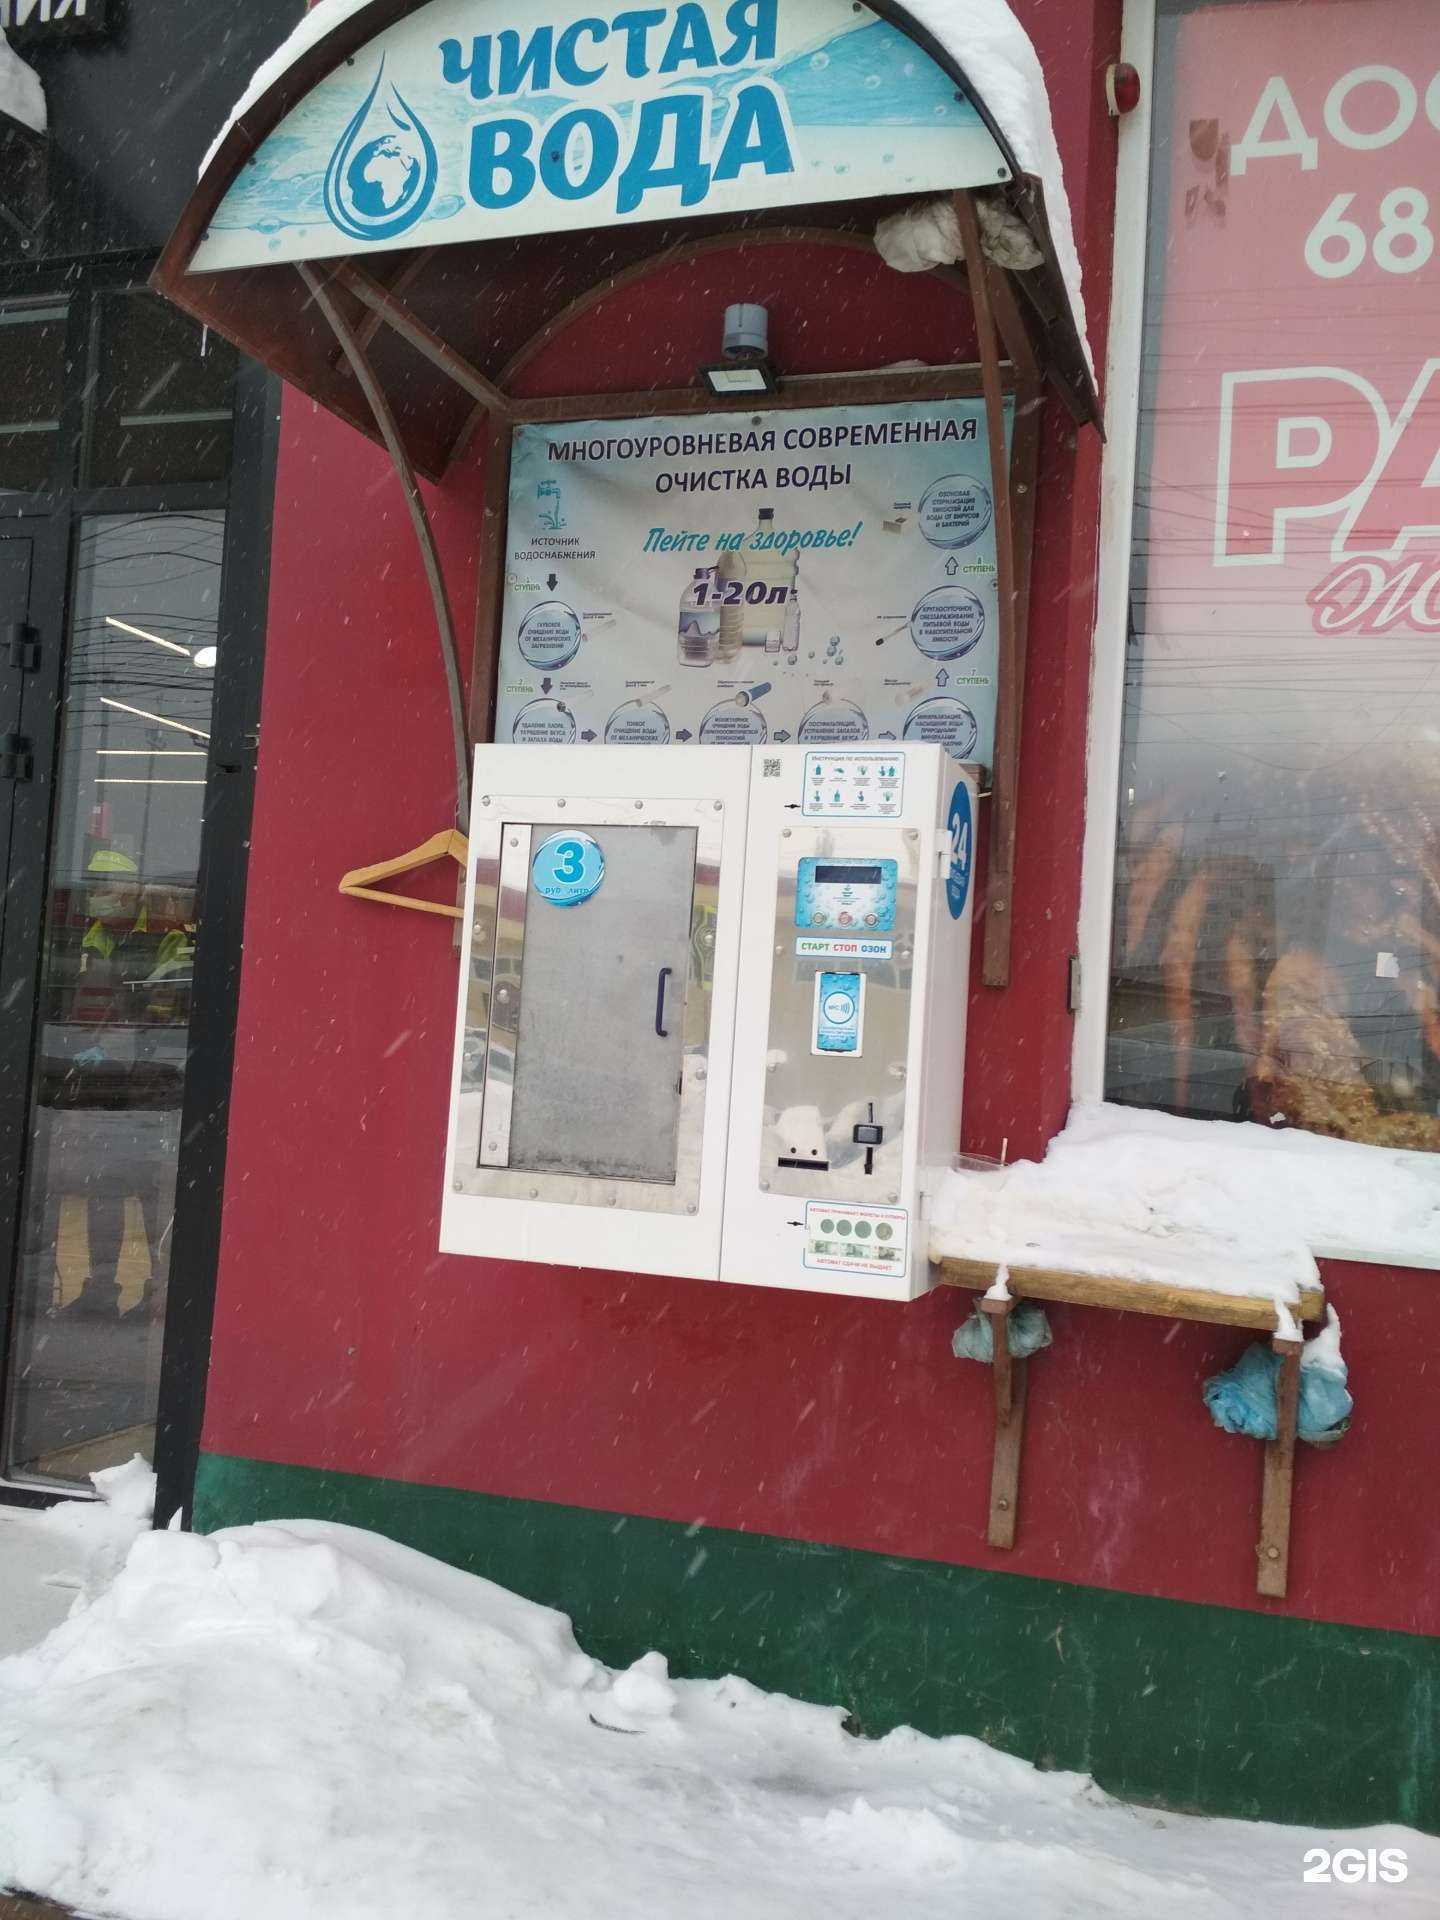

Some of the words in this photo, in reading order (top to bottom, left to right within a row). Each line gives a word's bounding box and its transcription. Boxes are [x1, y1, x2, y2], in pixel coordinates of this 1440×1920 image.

[439, 0, 778, 100] ЧИСТАЯ
[1230, 64, 1440, 176] ДО
[469, 85, 795, 214] ВОДА
[548, 430, 776, 461] МНОГОУРОВНЕВАЯ
[783, 418, 977, 450] СОВРЕМЕННАЯ
[656, 468, 769, 494] ОЧИСТКА
[776, 464, 851, 491] ВОДЫ
[514, 550, 596, 561] ВОДОСНАБЖЕНИЯ
[531, 537, 580, 546] ИСТОЧНИК
[643, 528, 710, 553] Пейте
[716, 532, 745, 551] на
[750, 521, 864, 556] здоровье!
[554, 841, 584, 883] 3
[801, 942, 830, 951] СТАРТ
[833, 944, 858, 952] СТОП
[861, 945, 887, 953] ОЗОН
